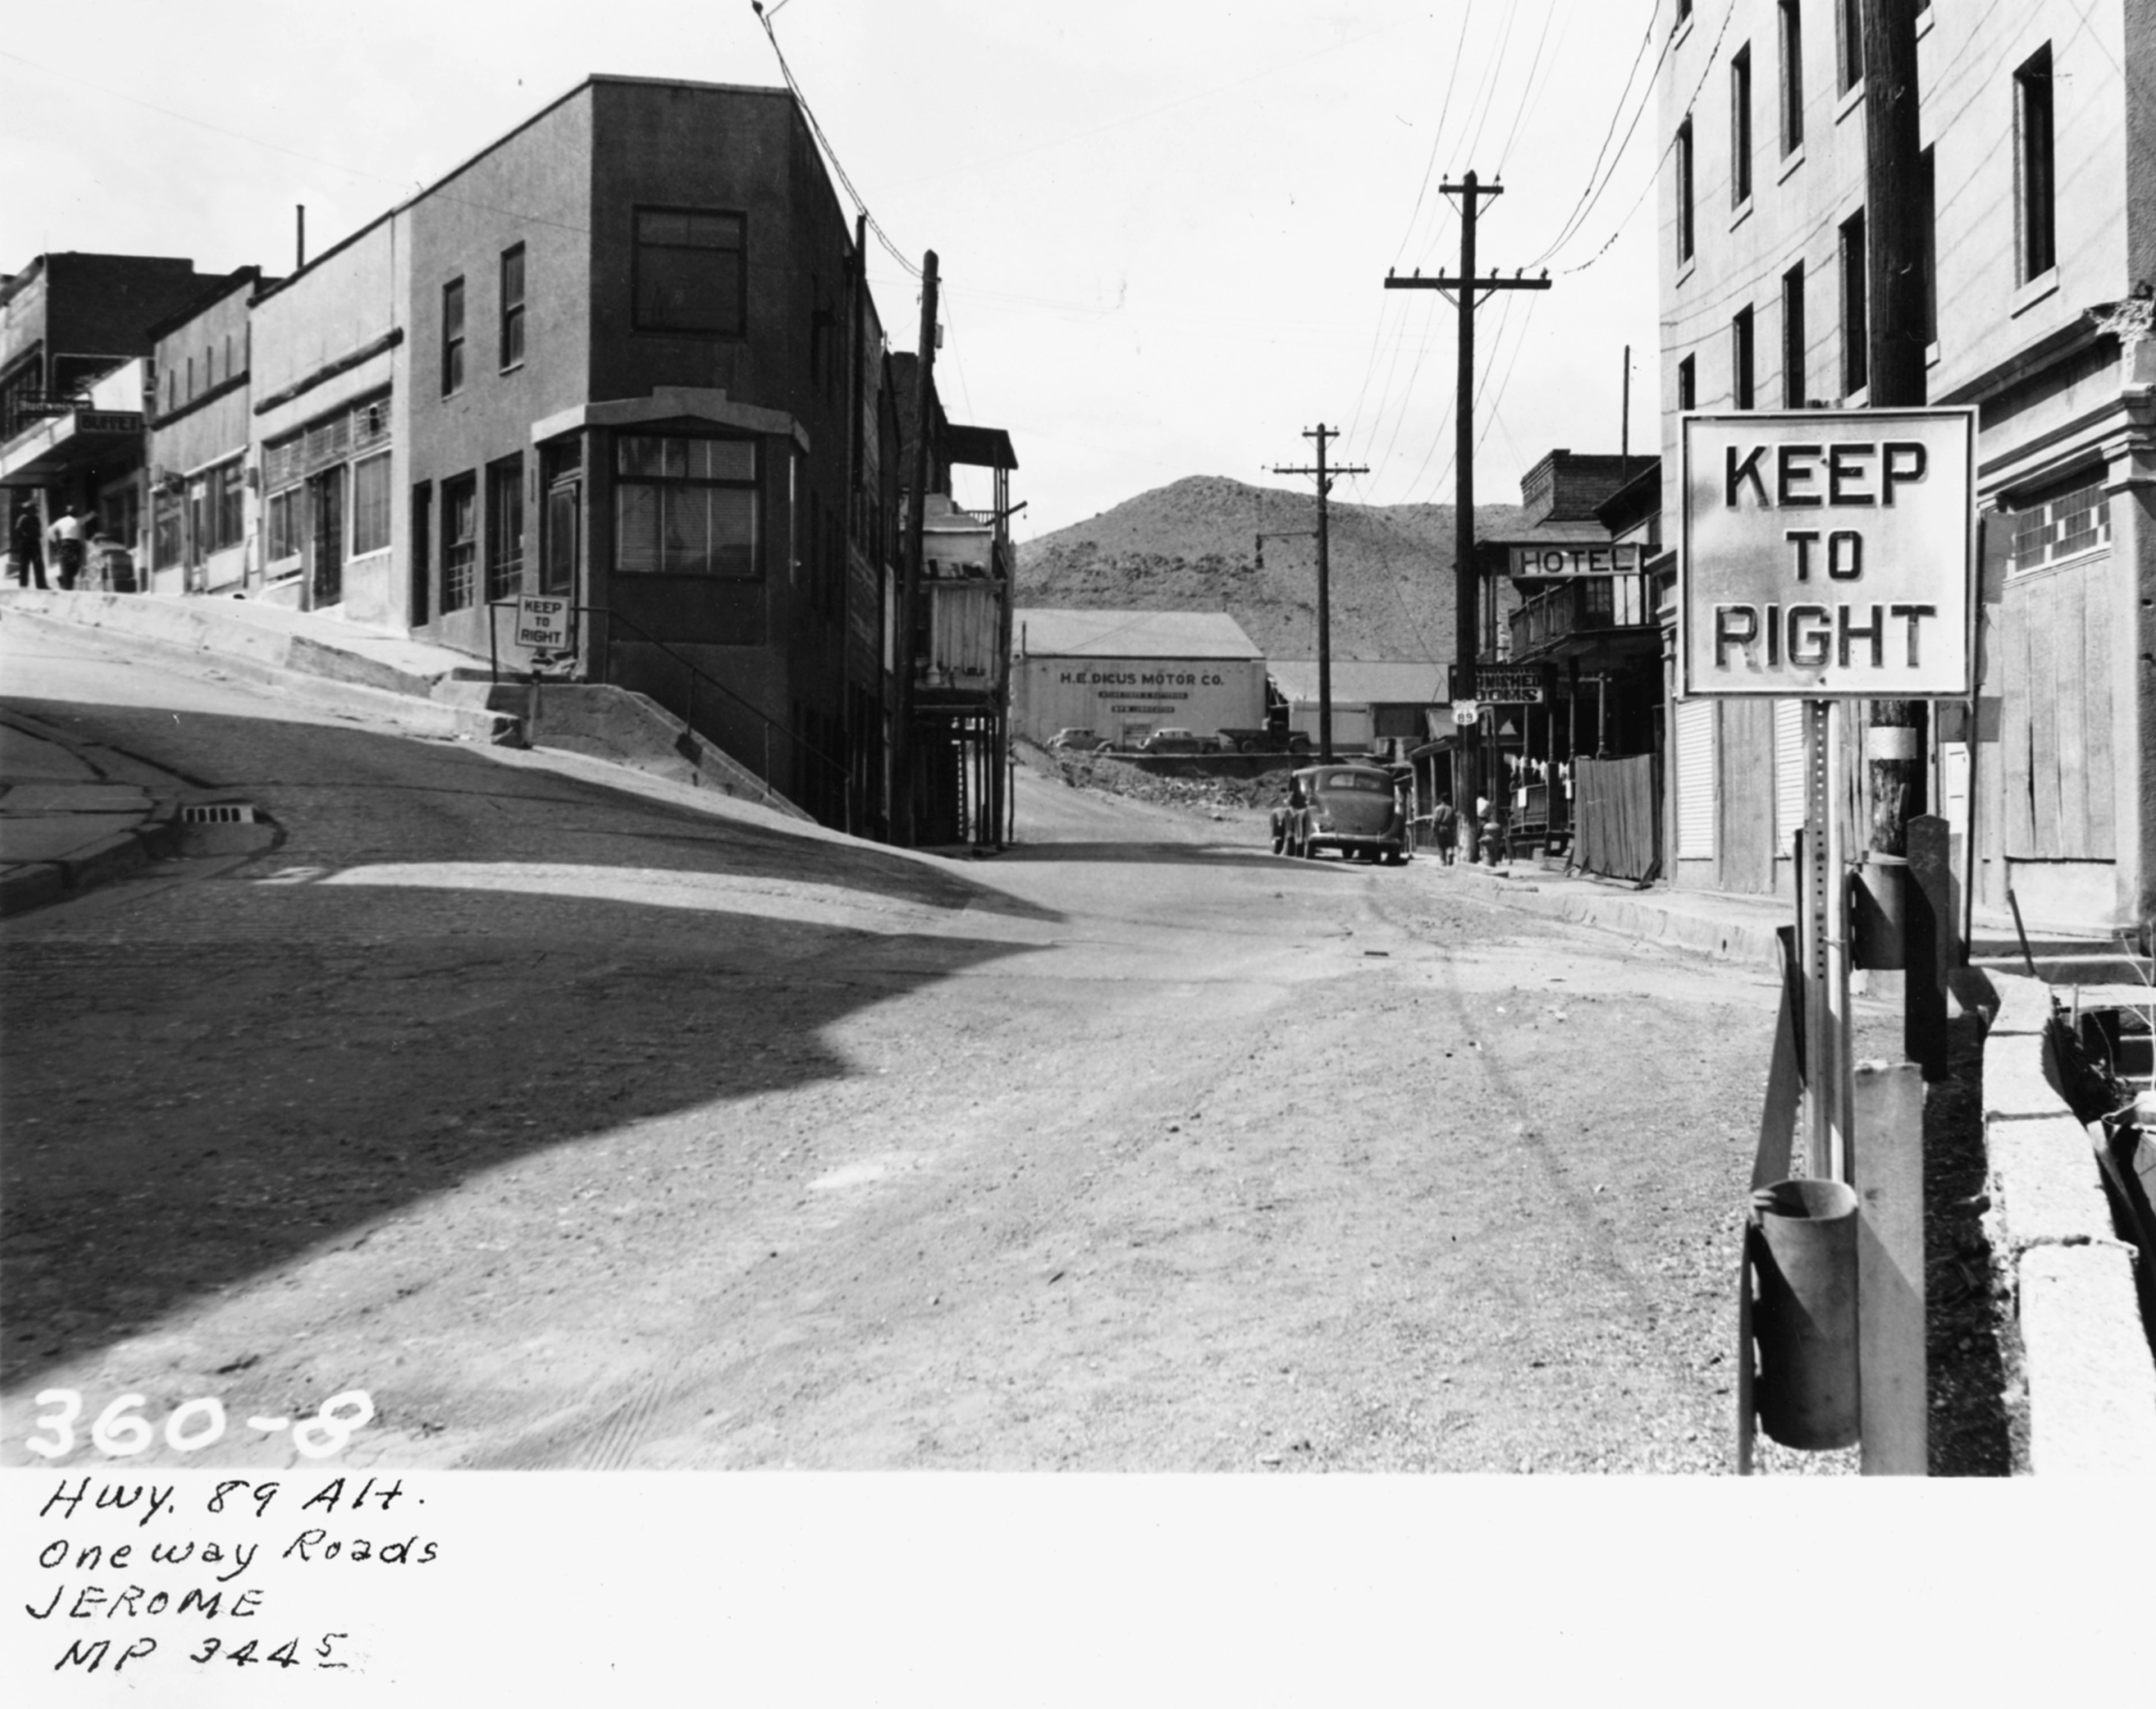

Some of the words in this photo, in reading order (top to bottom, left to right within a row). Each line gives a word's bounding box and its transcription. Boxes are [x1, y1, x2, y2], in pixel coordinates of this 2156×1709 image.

[82, 415, 139, 431] BUFFET
[1726, 442, 1928, 507] KEEP
[1521, 550, 1634, 574] HOTEL
[1786, 530, 1863, 581] TO
[524, 600, 562, 614] KEEP
[535, 616, 550, 627] TO
[521, 629, 562, 644] RIGHT
[1715, 604, 1936, 667] RIGHT
[1092, 673, 1136, 685] DICUS
[1142, 674, 1196, 685] MOTOR
[1201, 674, 1224, 685] CO.
[1457, 713, 1473, 723] 89
